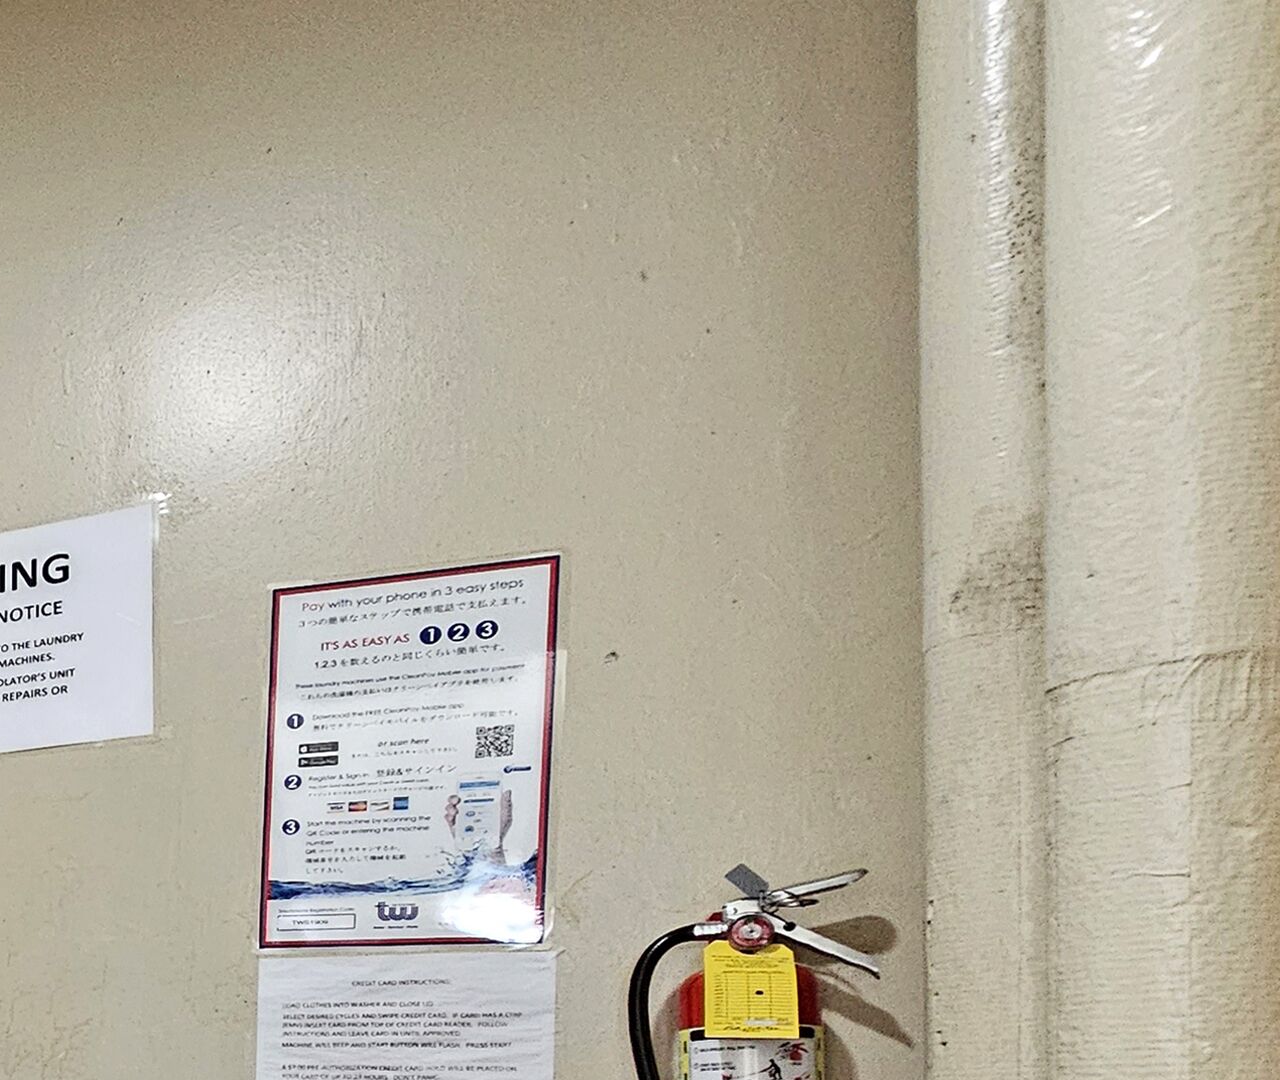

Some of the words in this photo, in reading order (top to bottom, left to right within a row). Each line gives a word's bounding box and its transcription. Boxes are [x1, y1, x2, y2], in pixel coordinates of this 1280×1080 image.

[302, 603, 325, 612] Pay
[328, 600, 352, 608] with
[357, 596, 383, 607] your
[386, 591, 427, 603] phone
[431, 589, 442, 597] in
[445, 586, 453, 596] 3
[456, 584, 487, 594] easy
[490, 579, 524, 590] steps
[12, 640, 31, 651] THE
[33, 632, 84, 648] LAUNDRY
[320, 641, 339, 651] IT'S
[342, 639, 358, 649] AS
[362, 635, 391, 647] EASY
[394, 634, 410, 644] AS
[49, 668, 76, 680] UNIT
[1, 687, 48, 703] REPAIRS
[50, 685, 69, 696] OR
